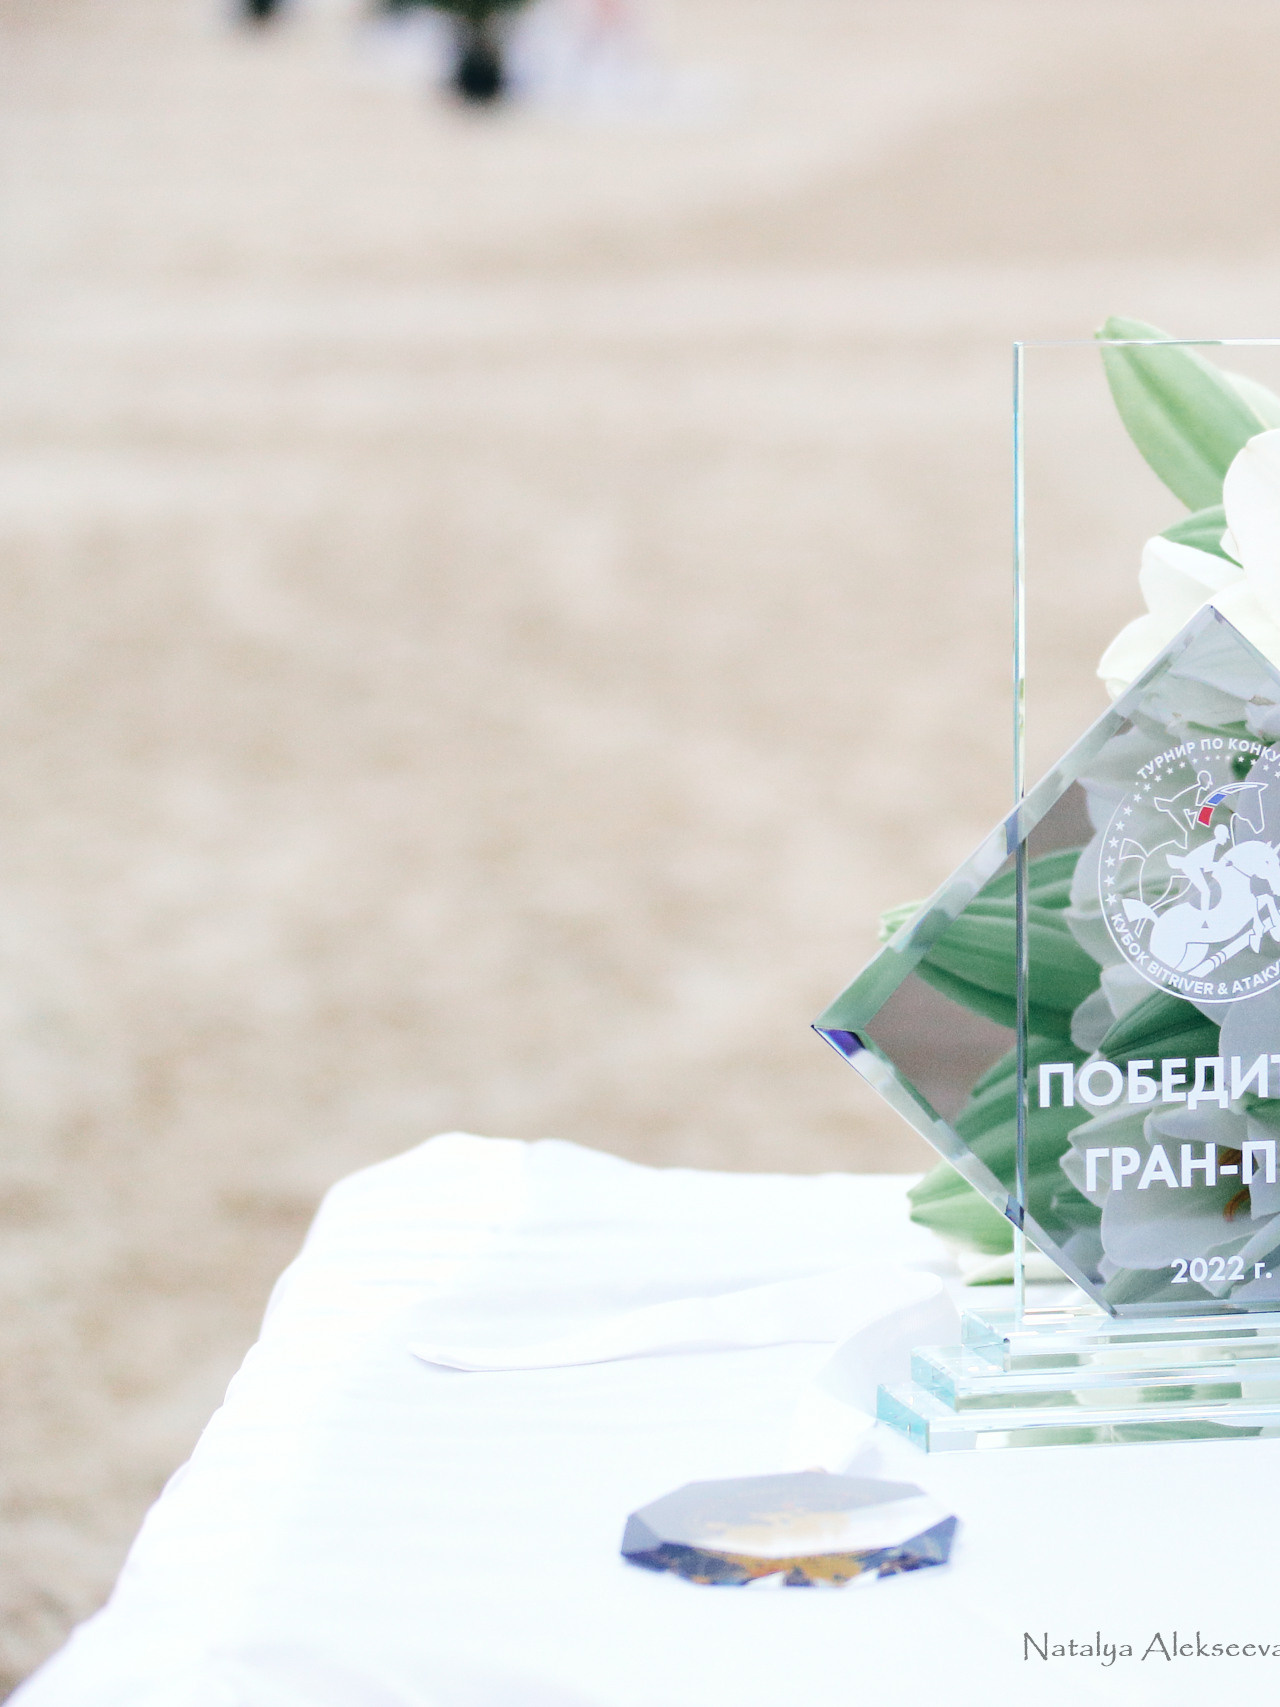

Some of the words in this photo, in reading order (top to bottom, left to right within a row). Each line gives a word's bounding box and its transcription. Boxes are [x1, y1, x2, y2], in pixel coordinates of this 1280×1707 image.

[1137, 741, 1195, 780] ТУРНИР
[1200, 737, 1223, 751] ПО
[1111, 913, 1151, 966] КУБОК
[1146, 959, 1214, 995] BITRIVER
[1217, 982, 1228, 995] &
[1170, 1256, 1245, 1284] 2022
[1253, 1261, 1273, 1280] г.
